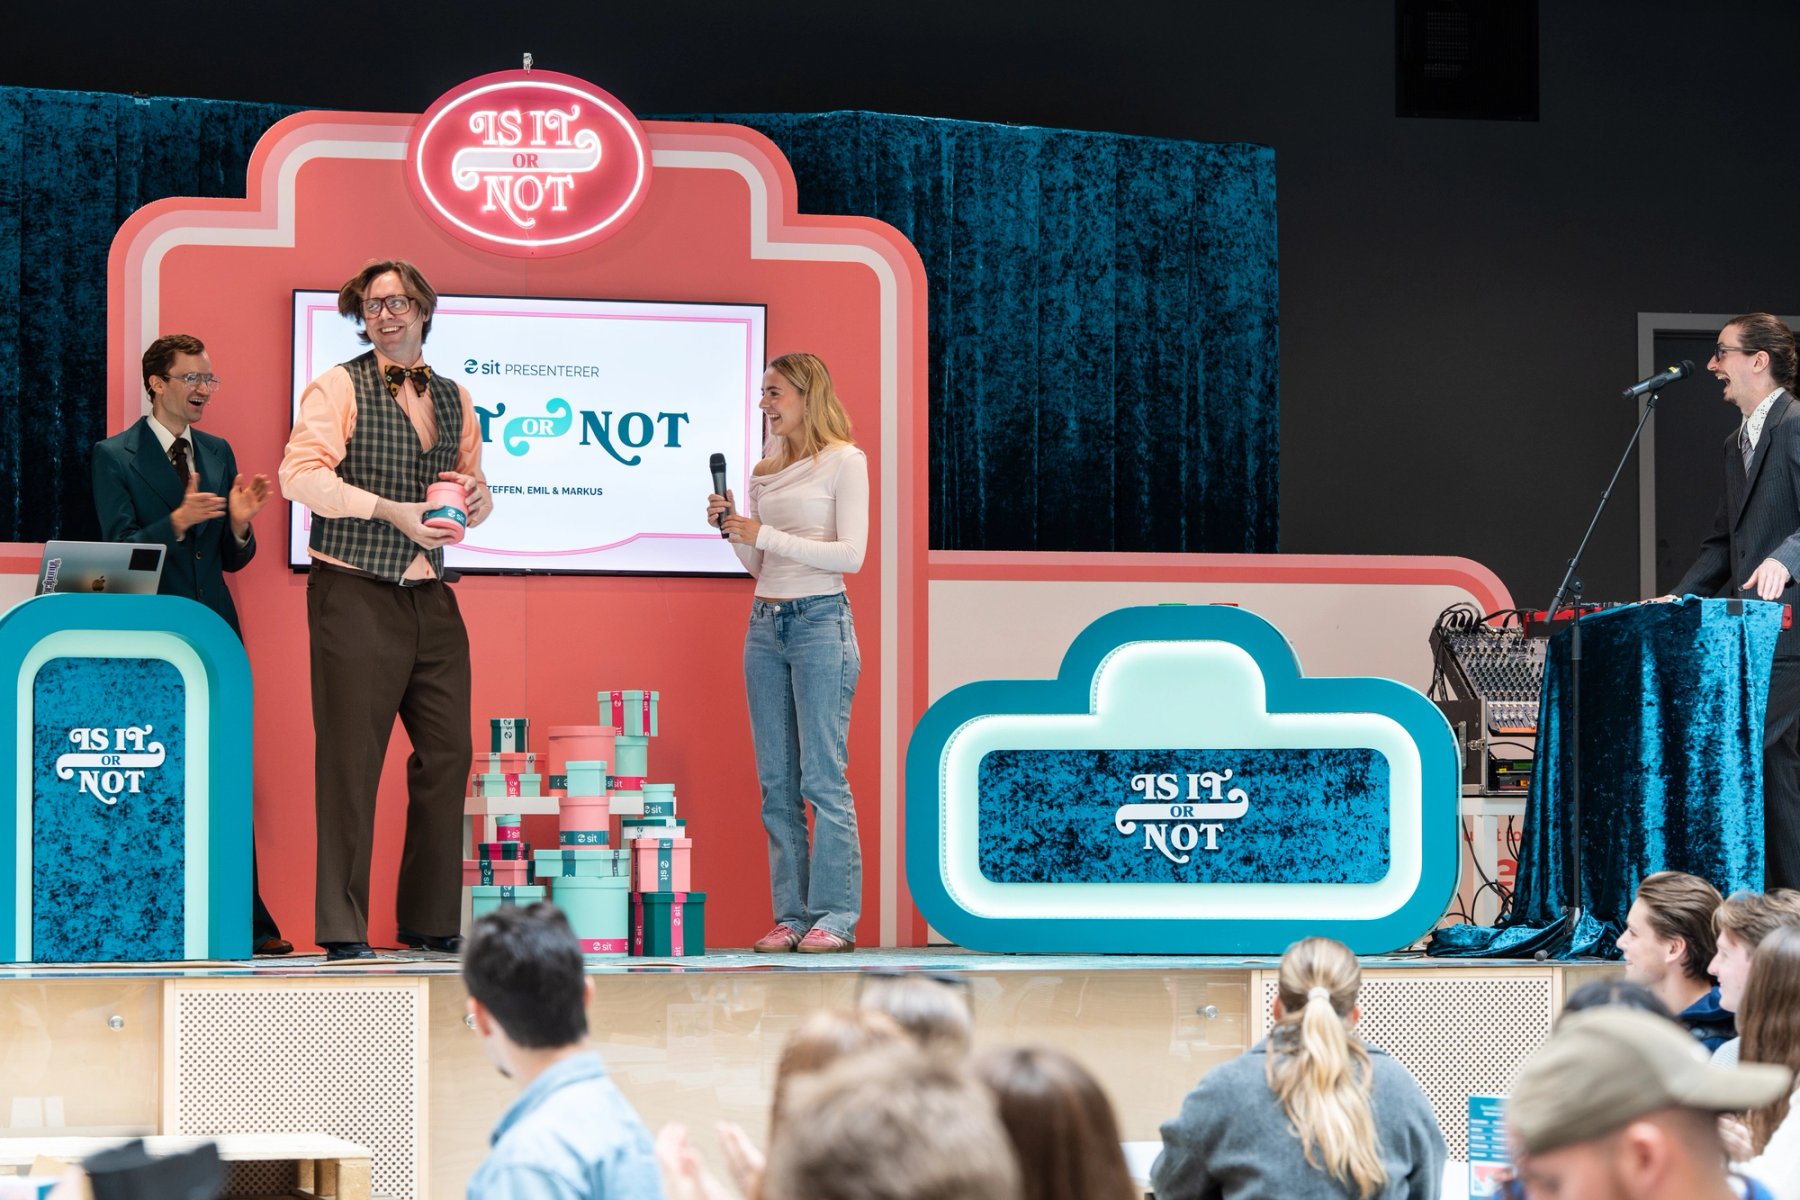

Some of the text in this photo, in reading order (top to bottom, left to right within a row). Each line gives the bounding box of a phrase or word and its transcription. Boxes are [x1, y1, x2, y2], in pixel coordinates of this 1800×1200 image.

[469, 104, 580, 146] IS IT
[512, 153, 539, 168] OR
[483, 174, 575, 229] NOT
[481, 359, 600, 378] sit PRESENTERER
[474, 402, 690, 466] T OR NOT
[487, 485, 603, 496] TEFFEN, EMIL & MARKUS
[69, 724, 153, 751] IS IT
[101, 755, 121, 766] OR
[79, 770, 145, 805] NOT
[1131, 768, 1233, 801] IS IT
[651, 805, 662, 814] sit
[1170, 805, 1194, 818] OR
[586, 833, 598, 843] sit
[1143, 823, 1225, 864] NOT
[660, 870, 669, 881] sit
[602, 942, 612, 951] sit
